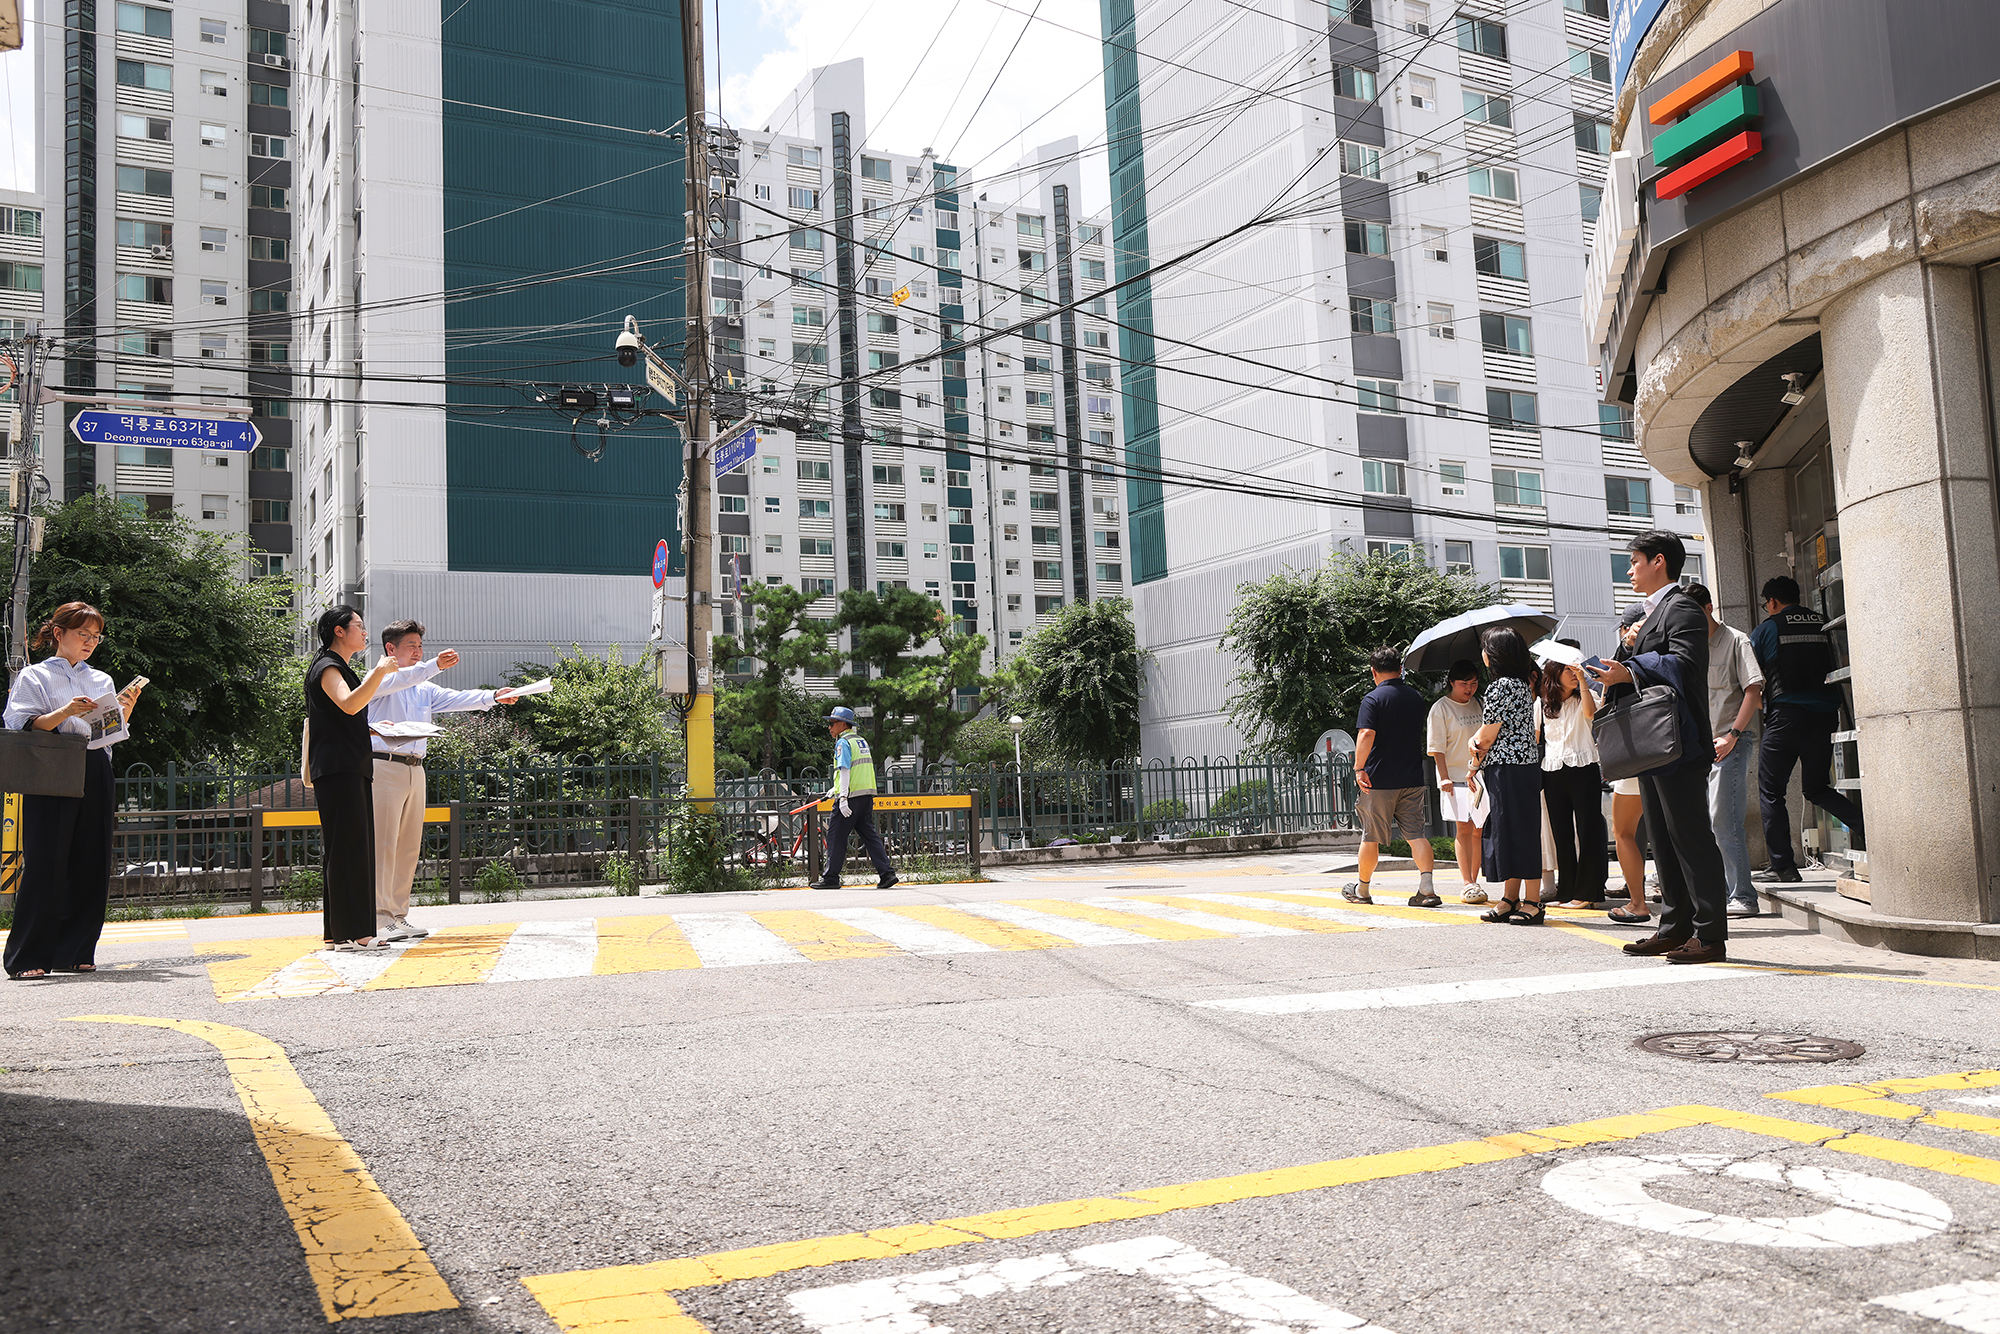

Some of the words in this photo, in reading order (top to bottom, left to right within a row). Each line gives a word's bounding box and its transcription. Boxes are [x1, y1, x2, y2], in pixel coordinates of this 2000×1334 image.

[83, 421, 98, 432] 37
[120, 416, 218, 436] 덕릉로63가길
[104, 432, 189, 447] Deongneung-ro
[191, 437, 233, 450] 63ga-gil
[239, 431, 252, 442] 41
[1785, 613, 1824, 622] POLICE
